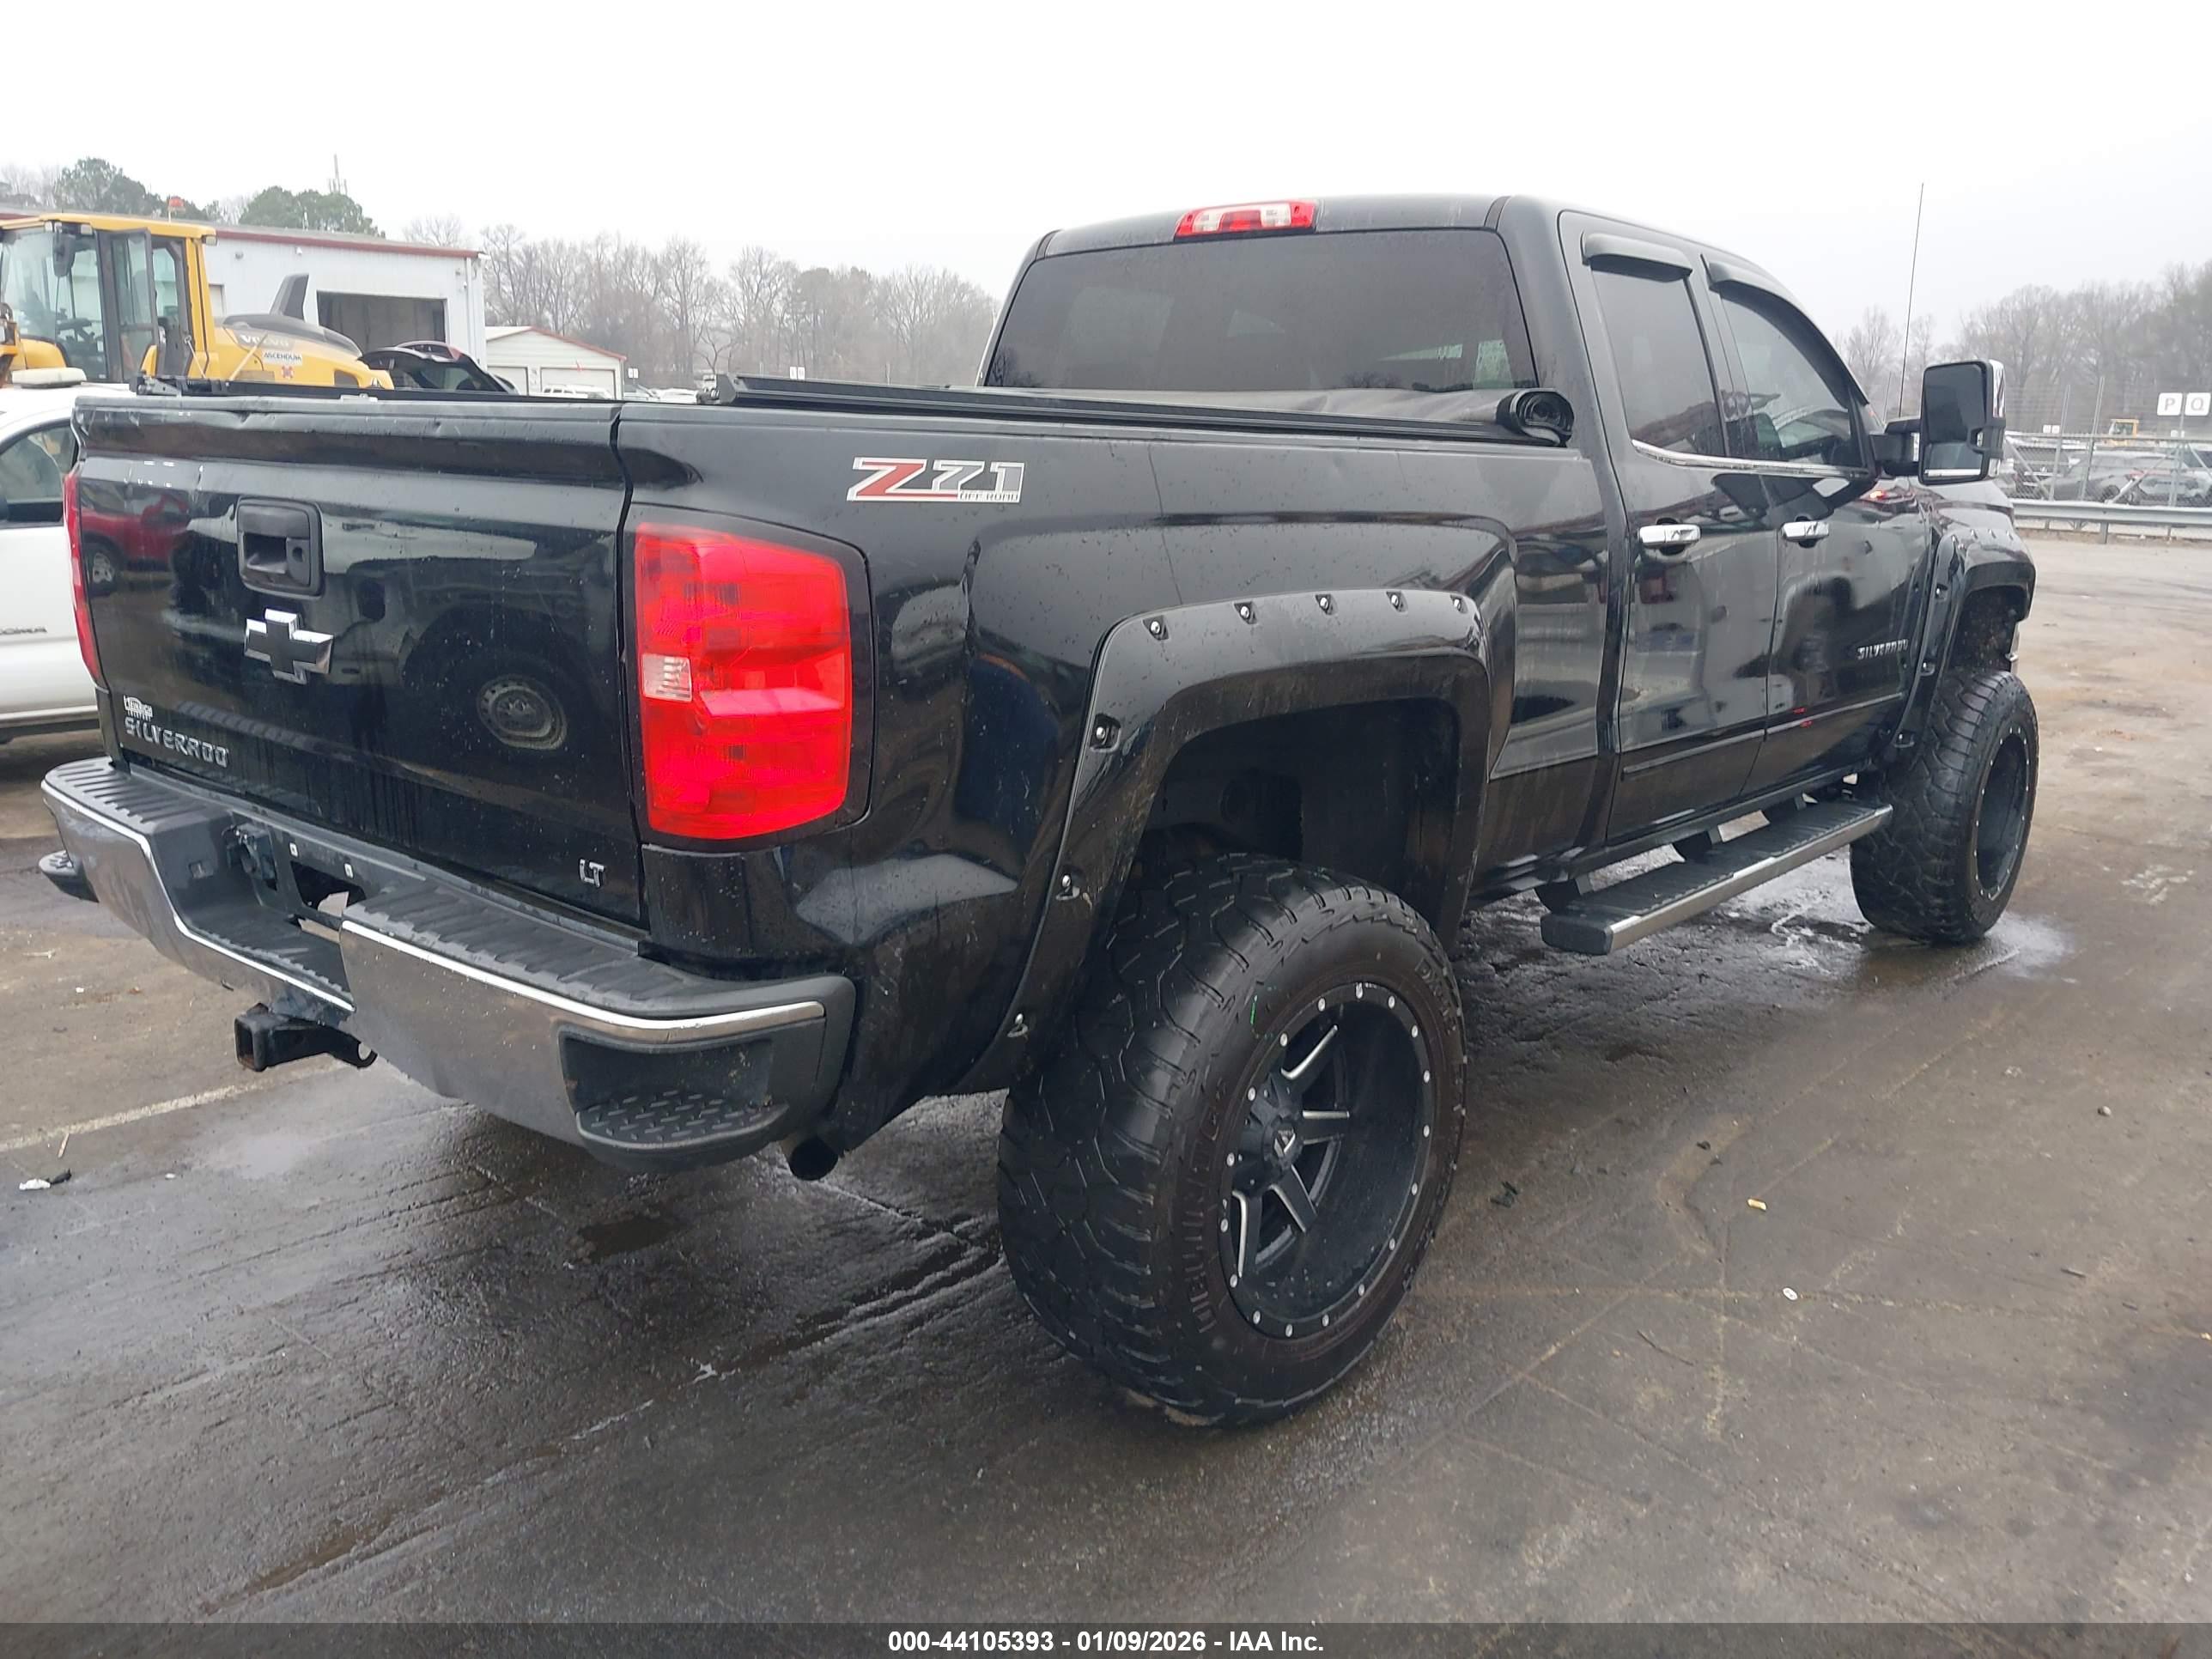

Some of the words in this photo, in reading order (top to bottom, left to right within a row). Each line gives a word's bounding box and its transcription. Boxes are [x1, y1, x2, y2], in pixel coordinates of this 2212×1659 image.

[2164, 398, 2176, 411] P
[2191, 398, 2205, 411] Q
[846, 457, 1024, 501] Z71
[1857, 639, 1908, 660] SILVERADO
[125, 716, 229, 768] SILVERADO
[579, 859, 605, 888] LT
